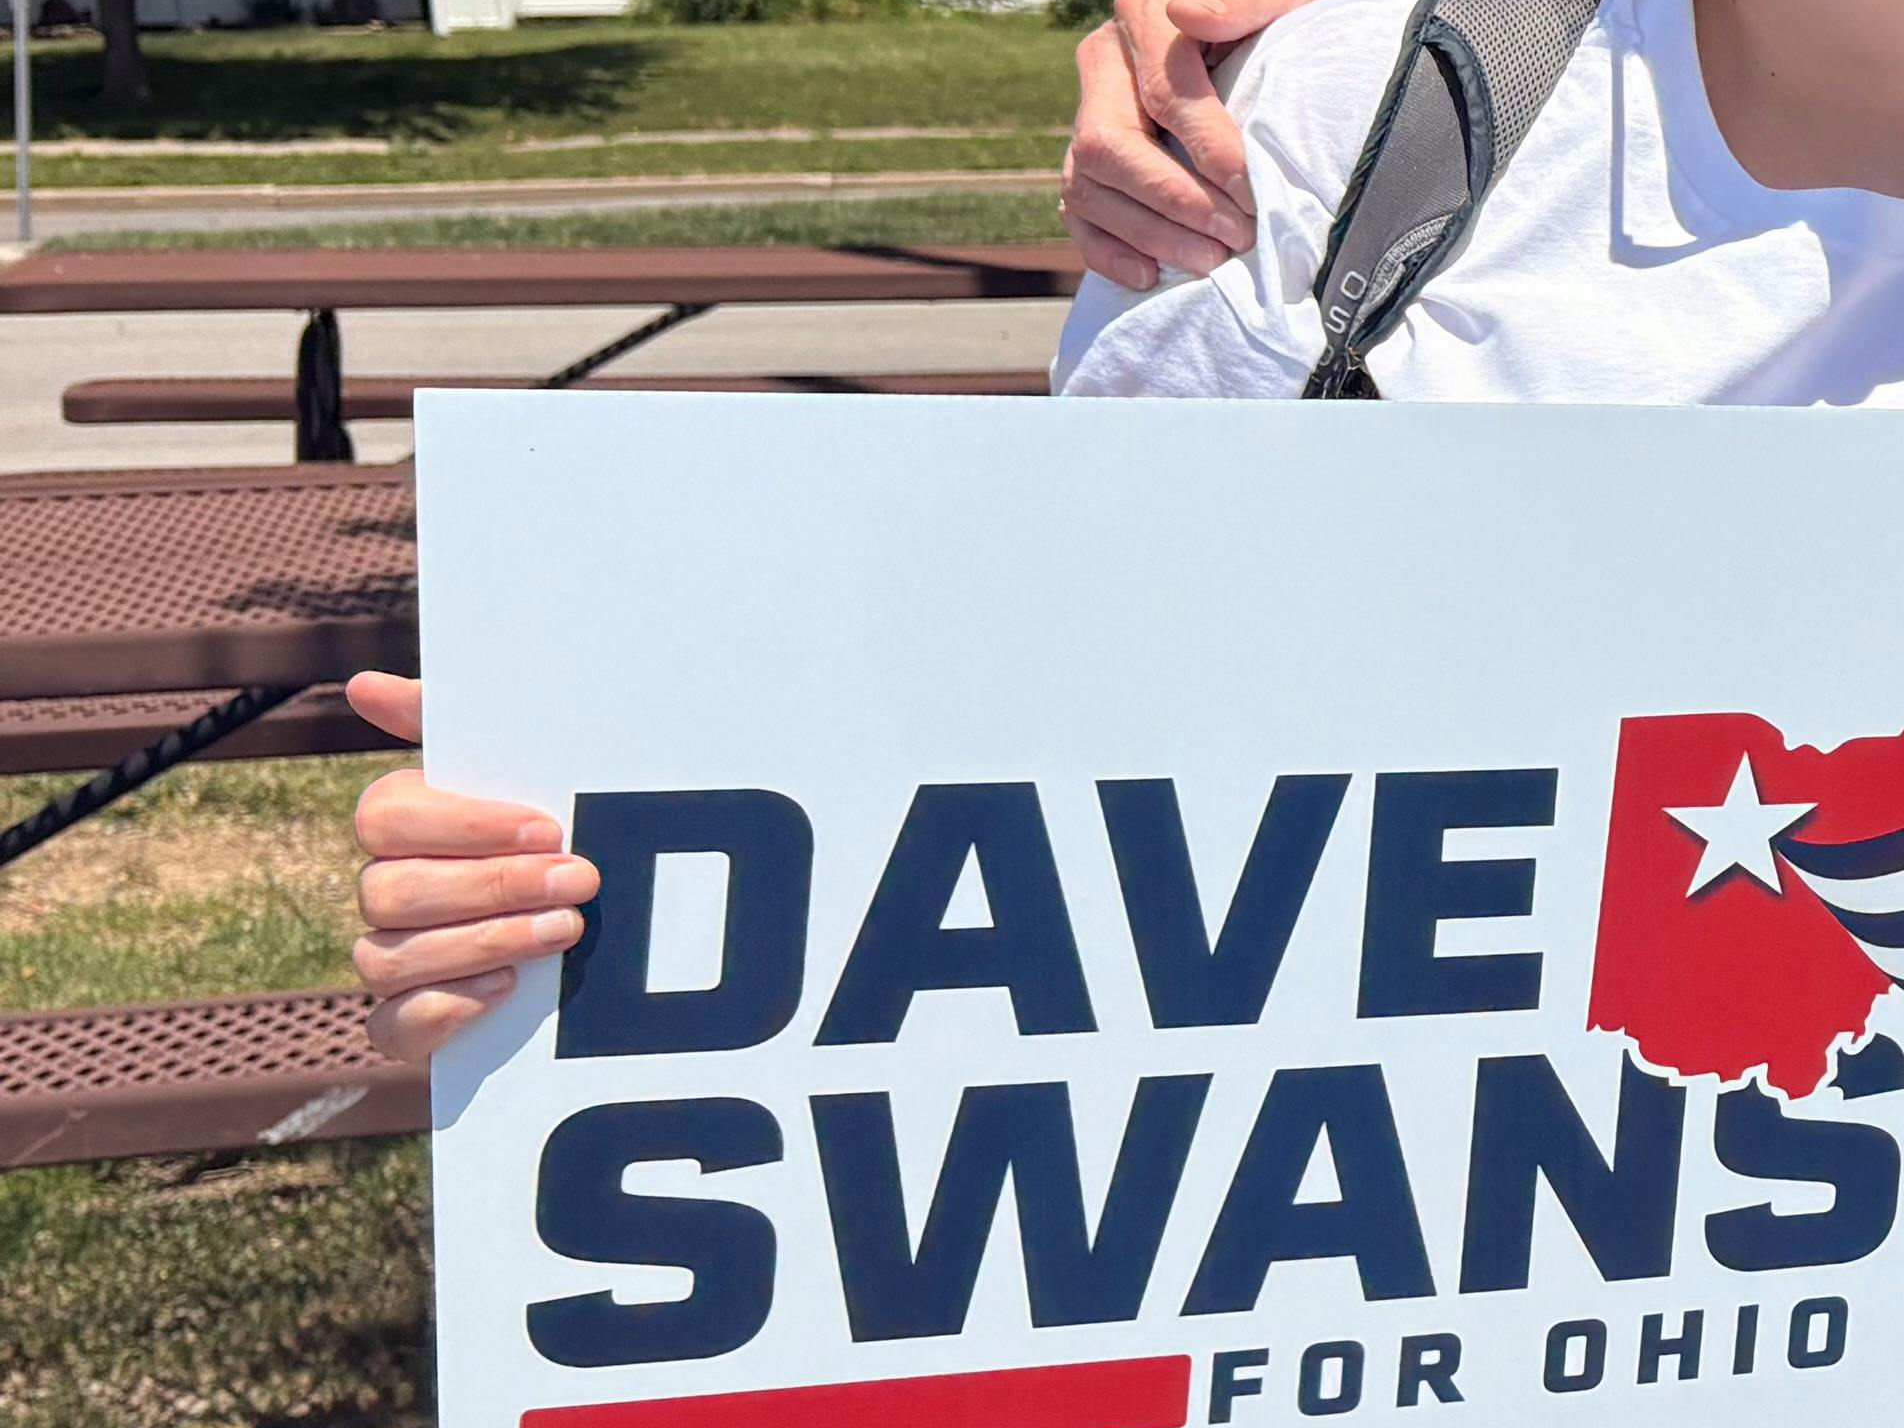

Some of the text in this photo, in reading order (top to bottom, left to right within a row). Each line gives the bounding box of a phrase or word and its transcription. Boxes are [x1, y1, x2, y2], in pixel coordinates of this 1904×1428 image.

[555, 767, 1558, 1059] DAVE
[1208, 1332, 1464, 1424] FOR
[1543, 1296, 1849, 1393] OHIO
